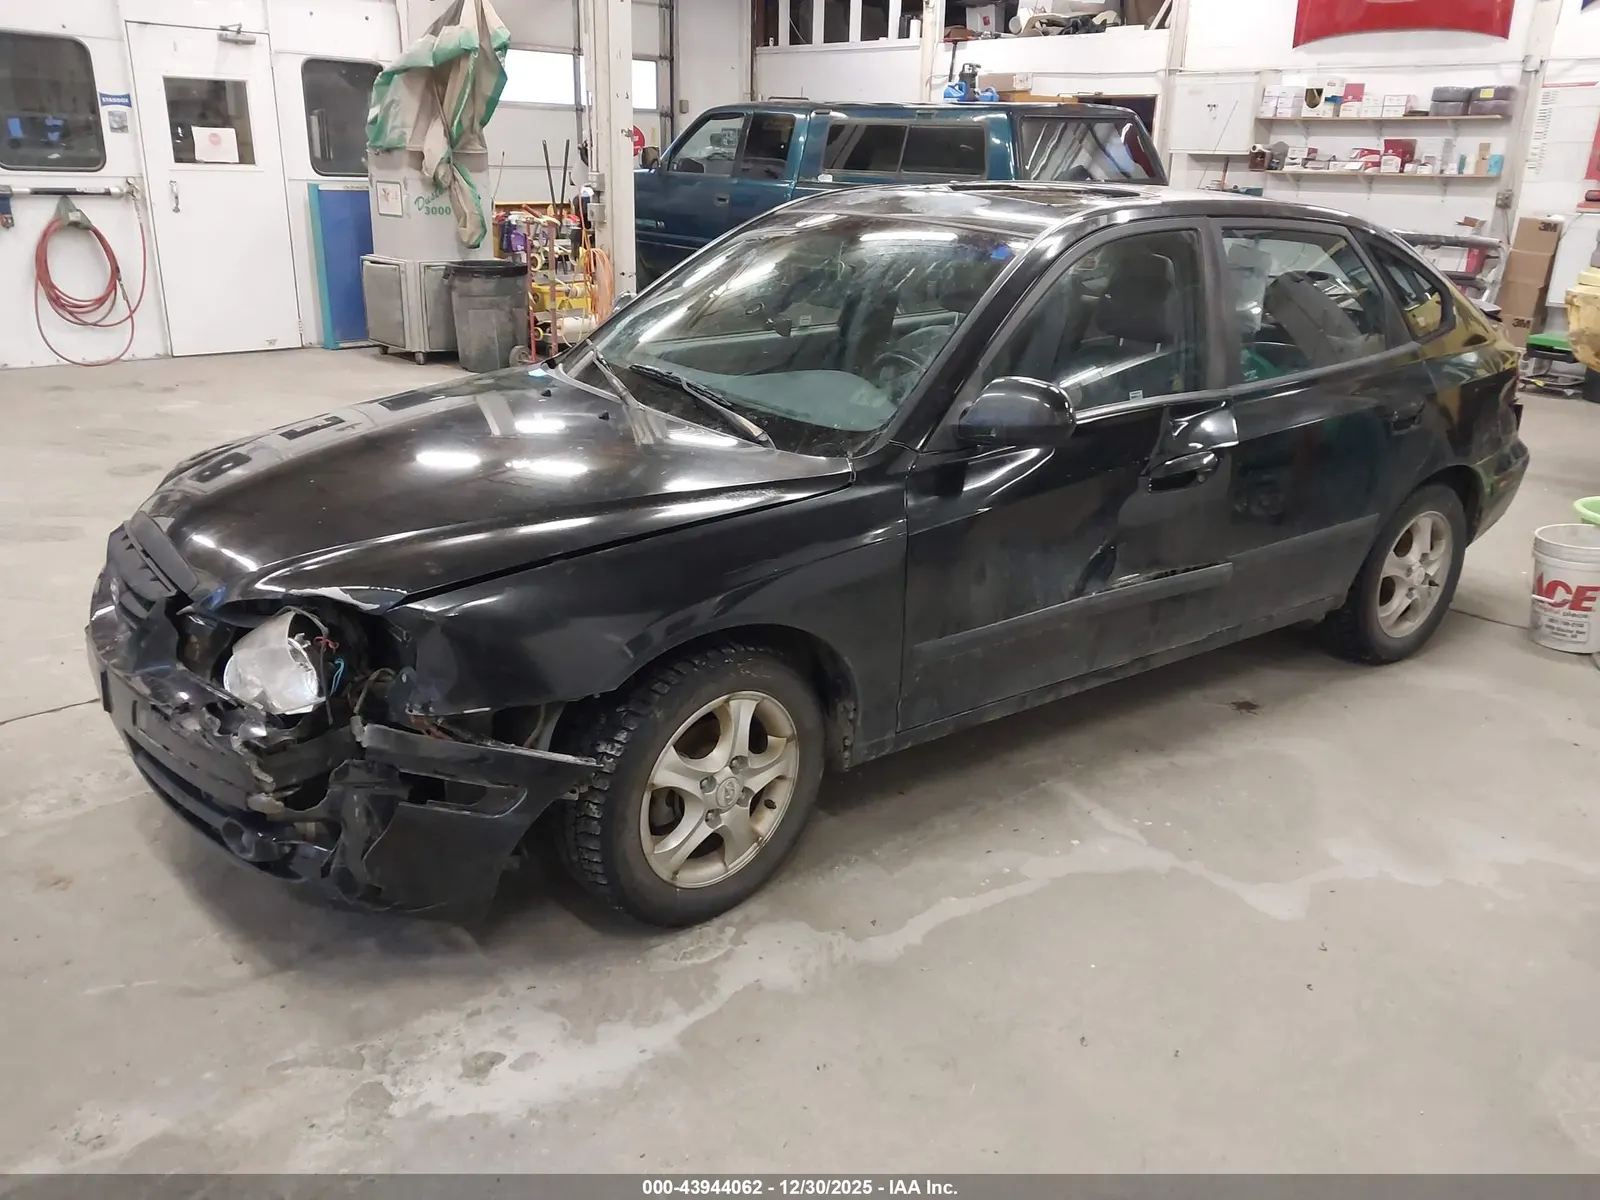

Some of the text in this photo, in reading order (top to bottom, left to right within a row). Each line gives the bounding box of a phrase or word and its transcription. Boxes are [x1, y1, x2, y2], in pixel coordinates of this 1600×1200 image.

[424, 206, 452, 215] 3000
[1538, 222, 1558, 233] 3M
[1512, 317, 1531, 329] 3M
[1536, 572, 1600, 612] ACE
